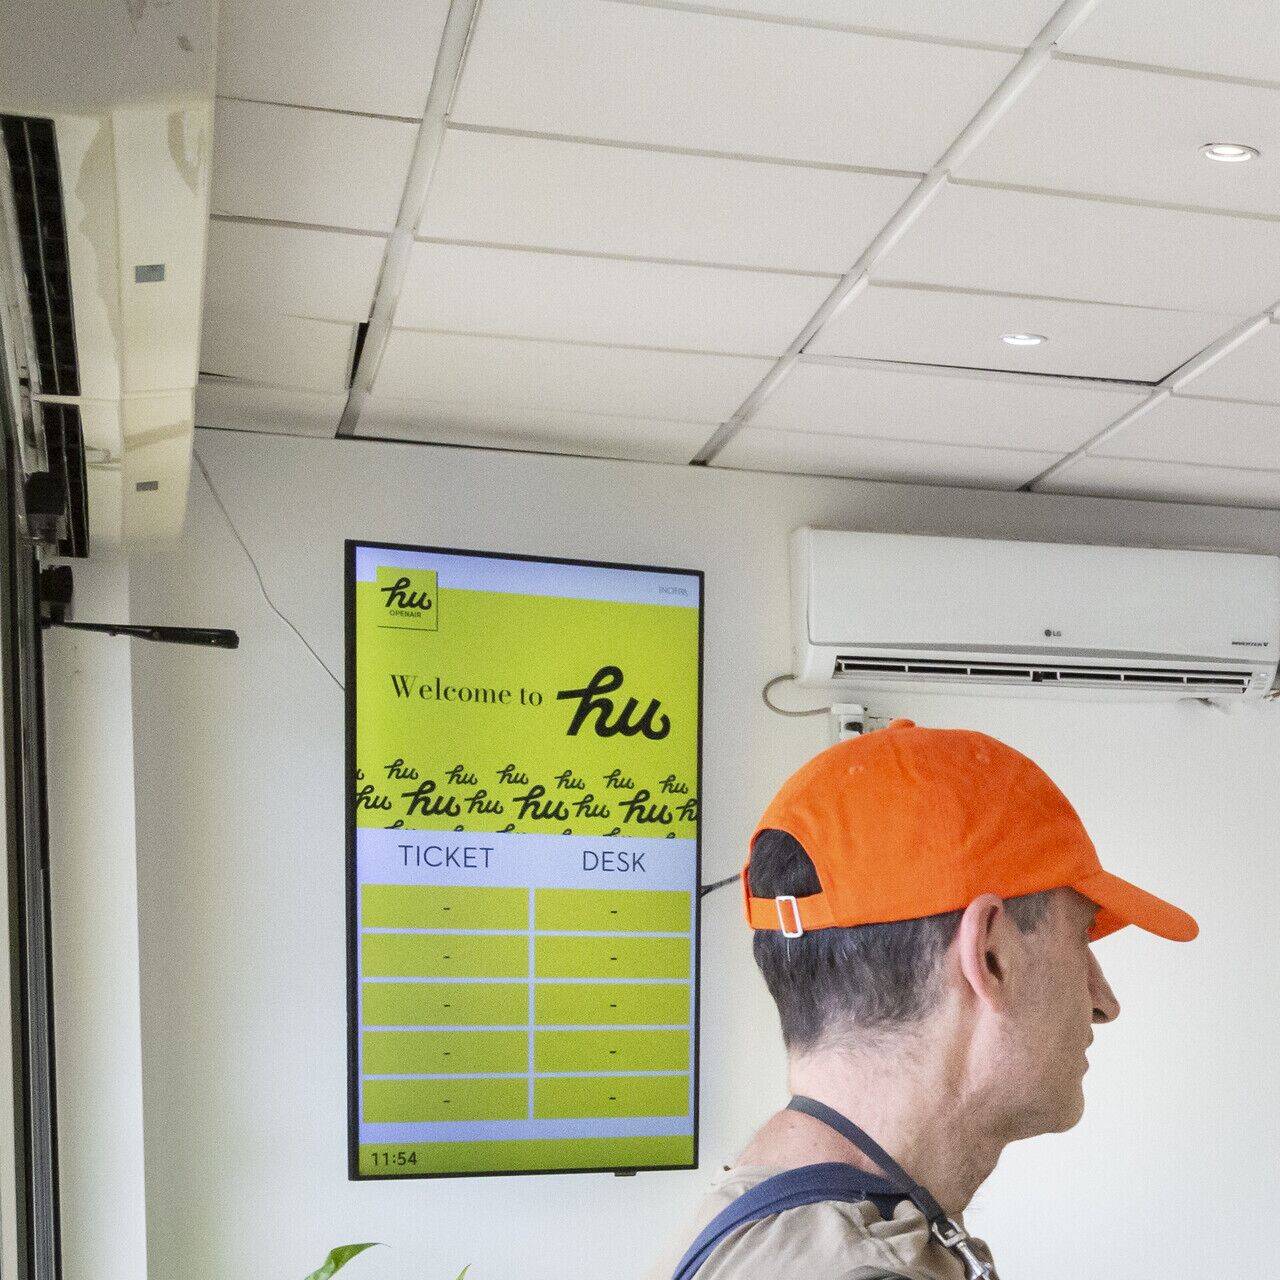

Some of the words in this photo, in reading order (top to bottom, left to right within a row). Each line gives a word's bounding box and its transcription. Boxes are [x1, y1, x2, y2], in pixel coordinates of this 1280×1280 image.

[381, 577, 432, 610] hu
[389, 610, 421, 618] OPENAIR
[390, 674, 512, 706] Welcome
[520, 687, 543, 707] to
[556, 665, 671, 741] hu
[398, 844, 494, 869] TICKET
[582, 850, 646, 873] DESK
[370, 1151, 418, 1167] 11:54
